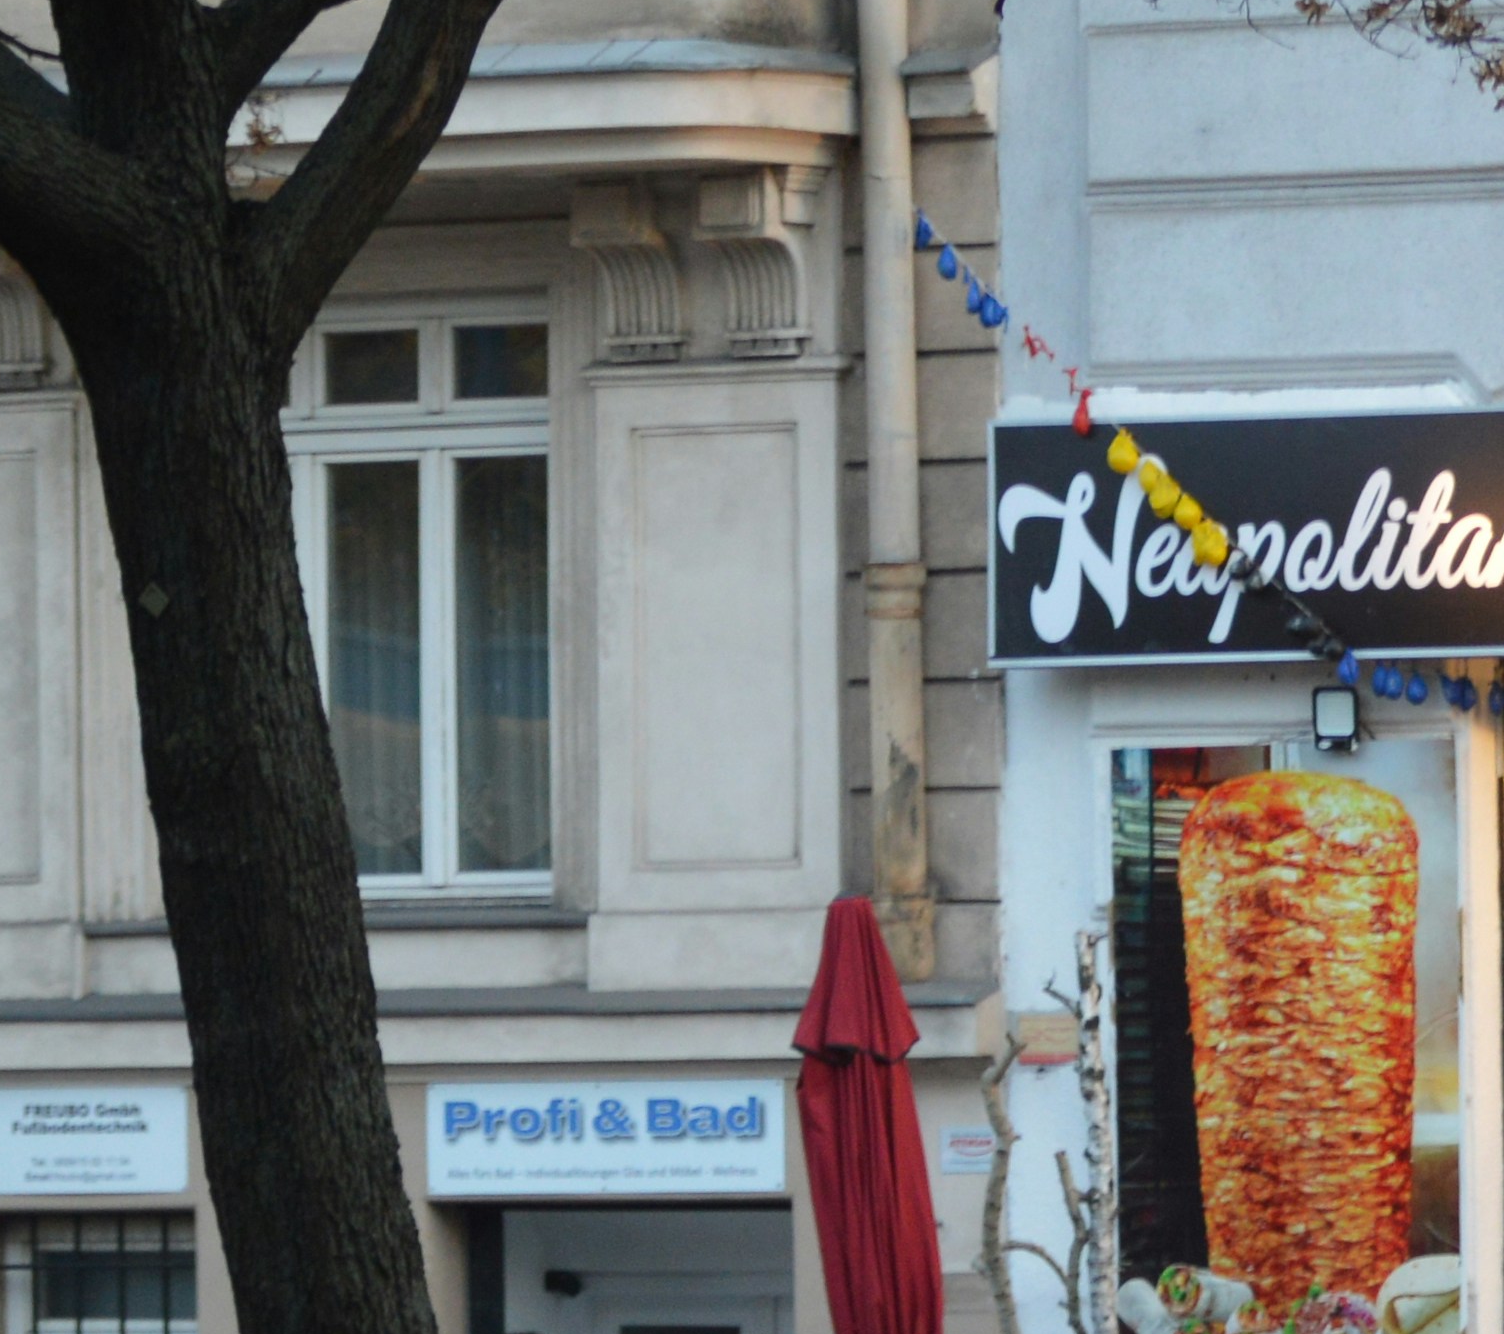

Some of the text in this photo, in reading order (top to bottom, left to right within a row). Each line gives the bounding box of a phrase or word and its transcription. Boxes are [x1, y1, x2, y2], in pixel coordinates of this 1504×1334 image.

[443, 1096, 764, 1141] Profi & Bad
